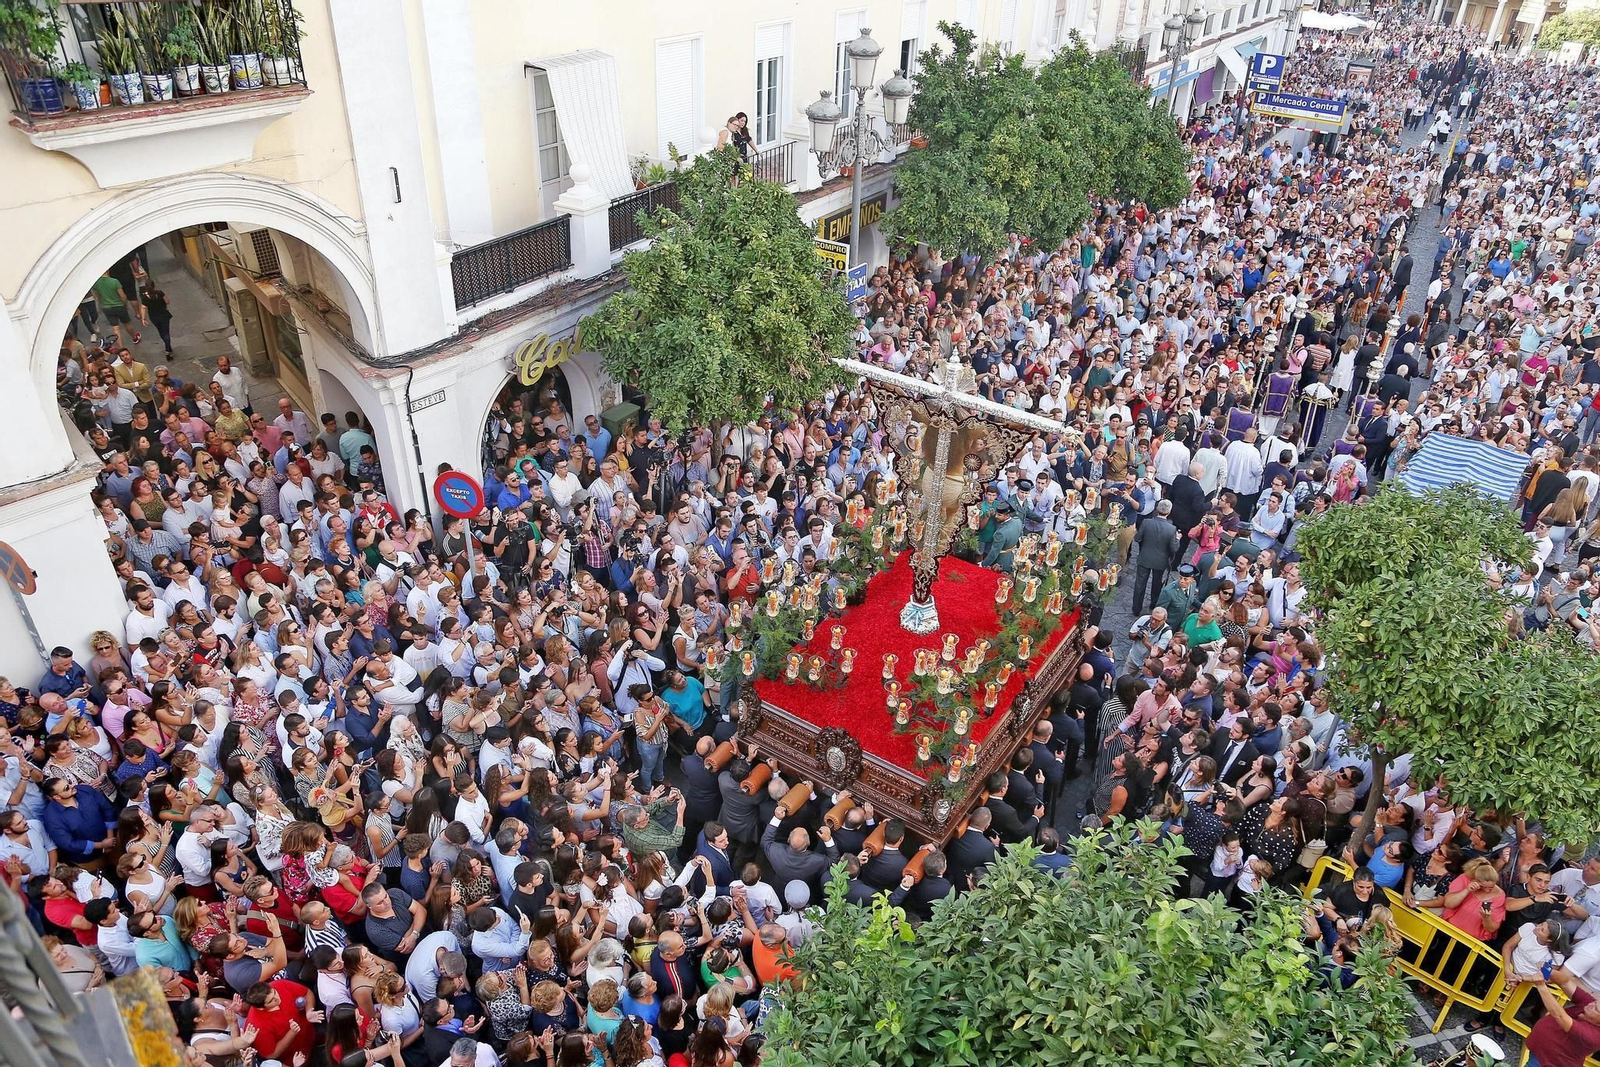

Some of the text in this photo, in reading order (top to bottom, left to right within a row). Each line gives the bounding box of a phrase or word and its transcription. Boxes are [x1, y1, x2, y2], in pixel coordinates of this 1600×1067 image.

[1260, 55, 1277, 74] P
[1257, 93, 1267, 103] P
[1271, 95, 1307, 108] Mercado
[829, 200, 882, 241] EMPÑOS
[815, 241, 847, 254] COMPRO
[821, 256, 846, 271] RO
[848, 275, 866, 292] TAXI
[411, 392, 444, 411] ESTEVE
[445, 487, 471, 496] EXCEPTO
